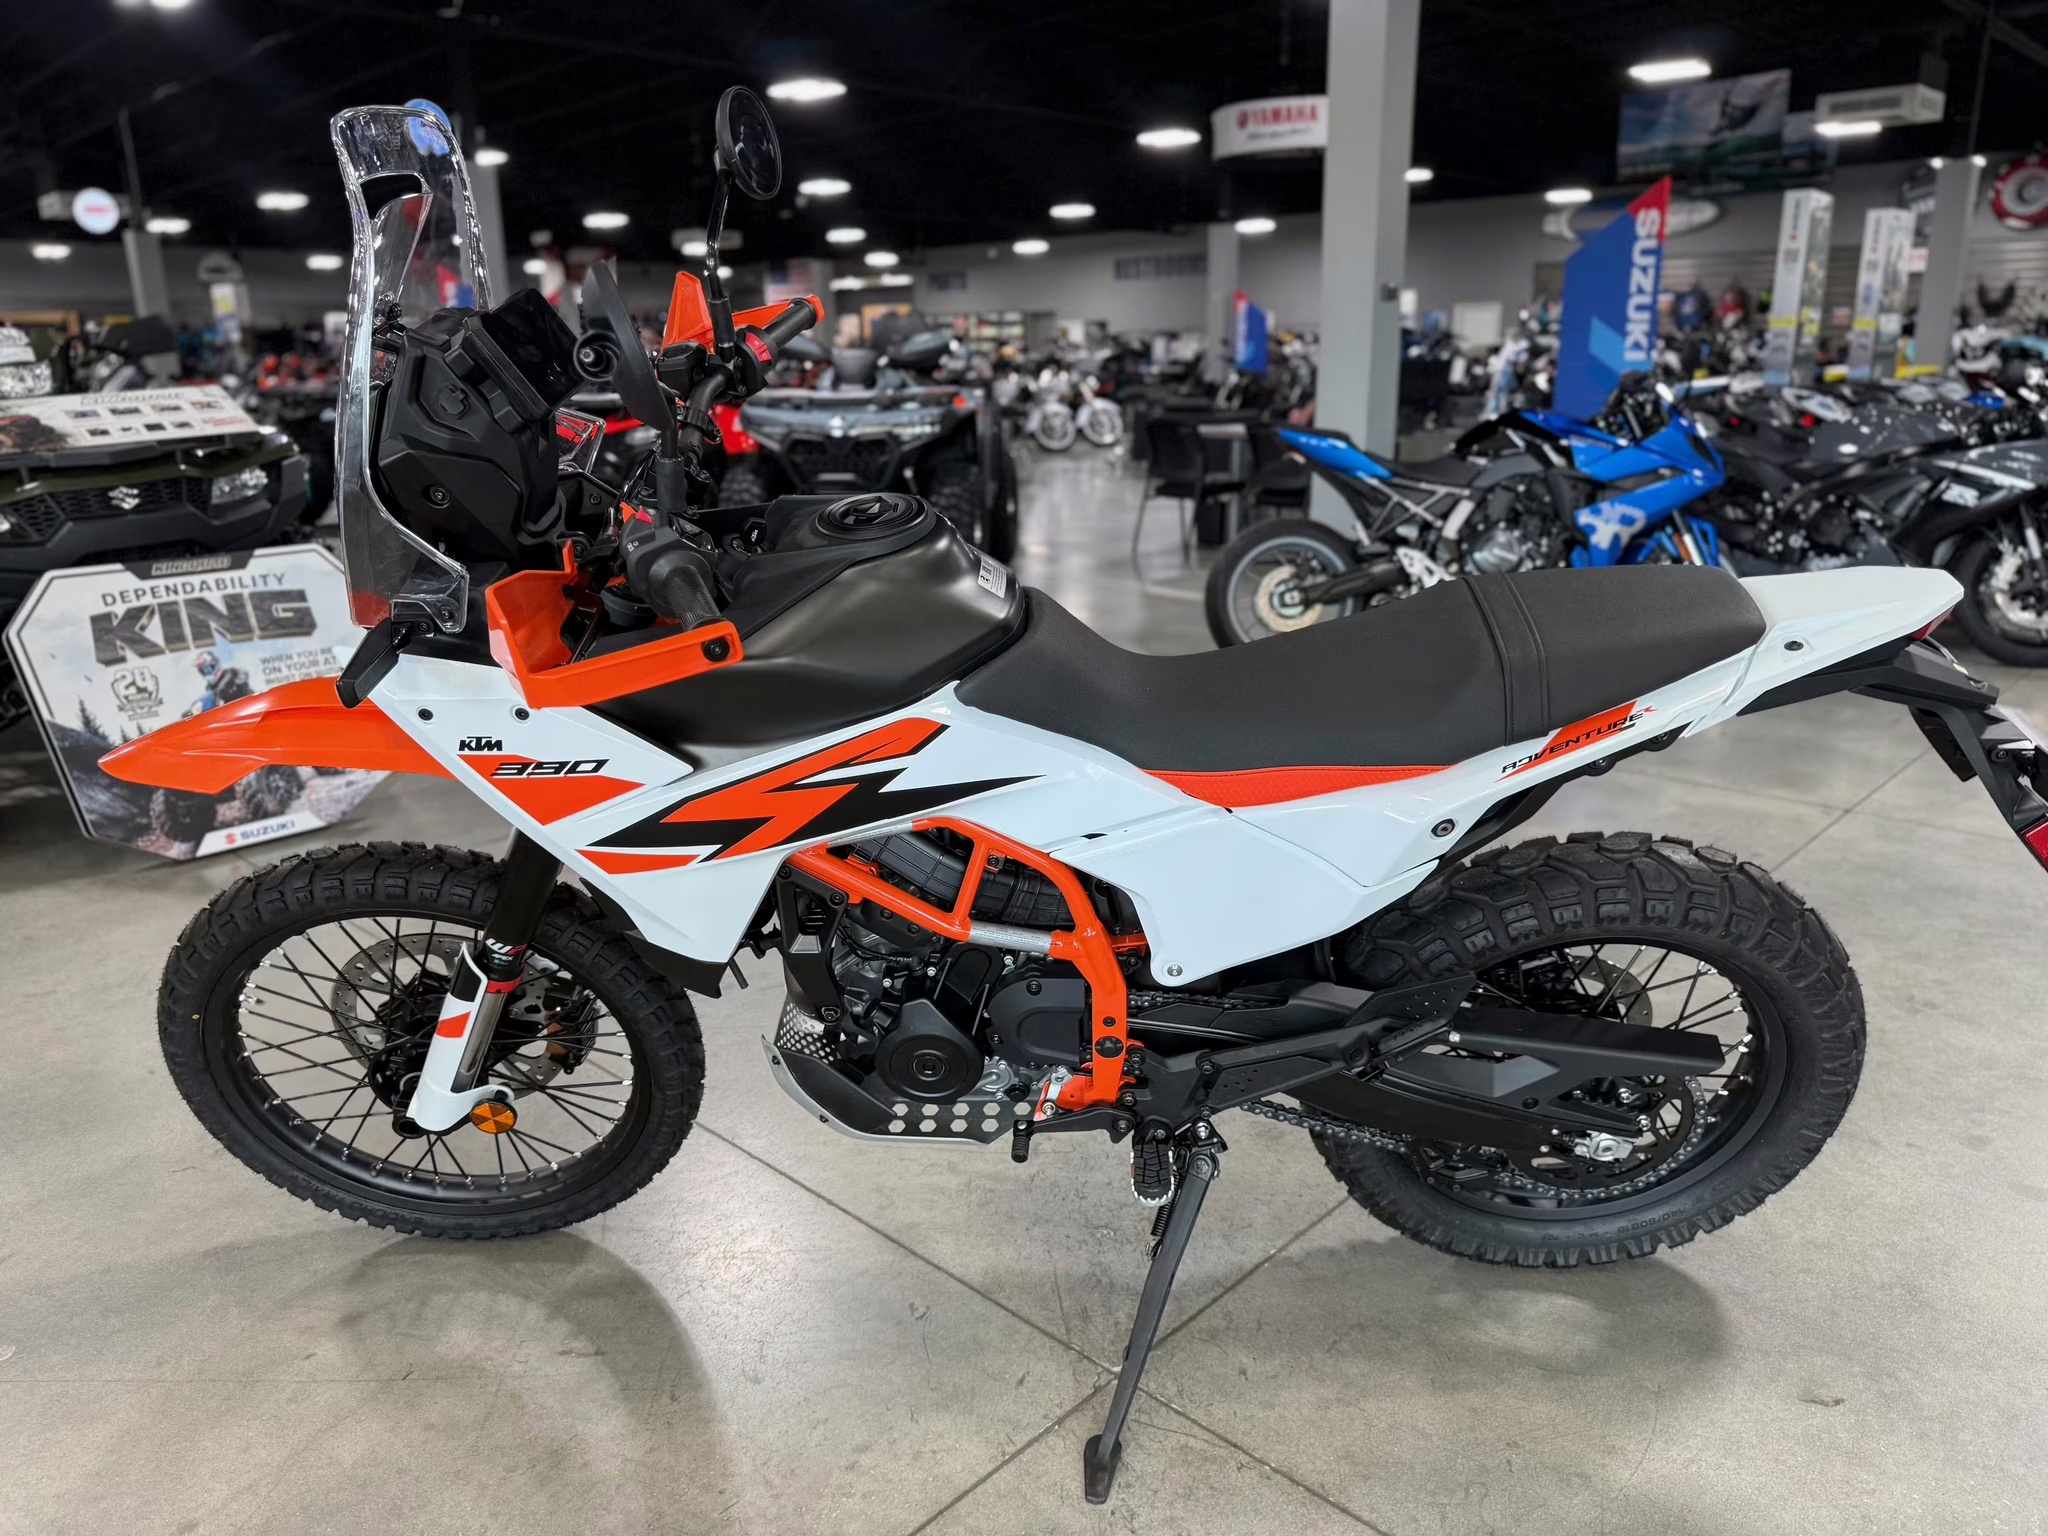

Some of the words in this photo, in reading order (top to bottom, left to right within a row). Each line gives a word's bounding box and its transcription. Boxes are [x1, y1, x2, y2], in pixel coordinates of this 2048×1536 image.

[1623, 207, 1662, 362] SUZUKI
[101, 573, 286, 607] DEPENDABILITY
[89, 588, 318, 668] KING
[259, 653, 294, 665] WHEN
[262, 665, 283, 676] ON
[458, 736, 503, 752] KTM
[1501, 712, 1644, 774] ADVENTURE
[489, 758, 611, 777] 390
[240, 820, 295, 840] SUZUKI
